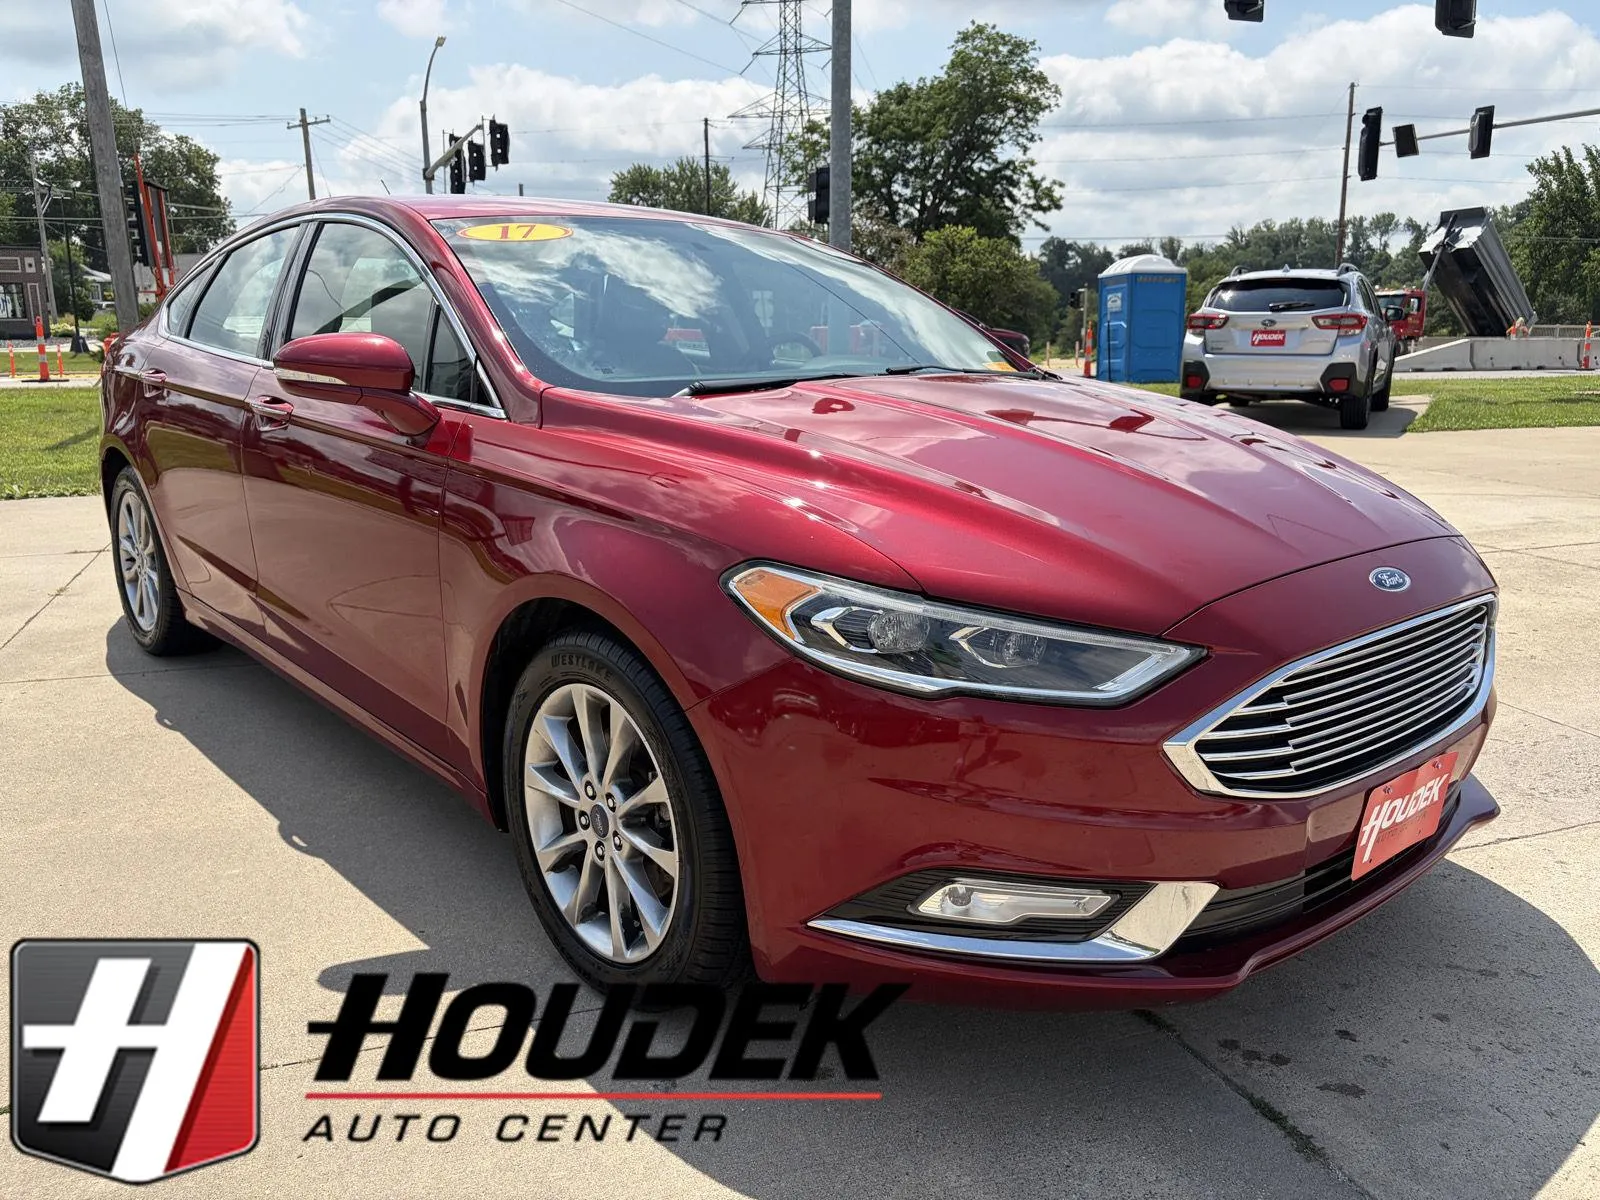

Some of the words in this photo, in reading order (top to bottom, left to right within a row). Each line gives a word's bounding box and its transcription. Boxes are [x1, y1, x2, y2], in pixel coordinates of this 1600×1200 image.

[497, 224, 537, 240] 17
[1378, 572, 1403, 587] Ford
[551, 653, 612, 682] WESTLAKE
[1360, 772, 1449, 864] HOUDEK
